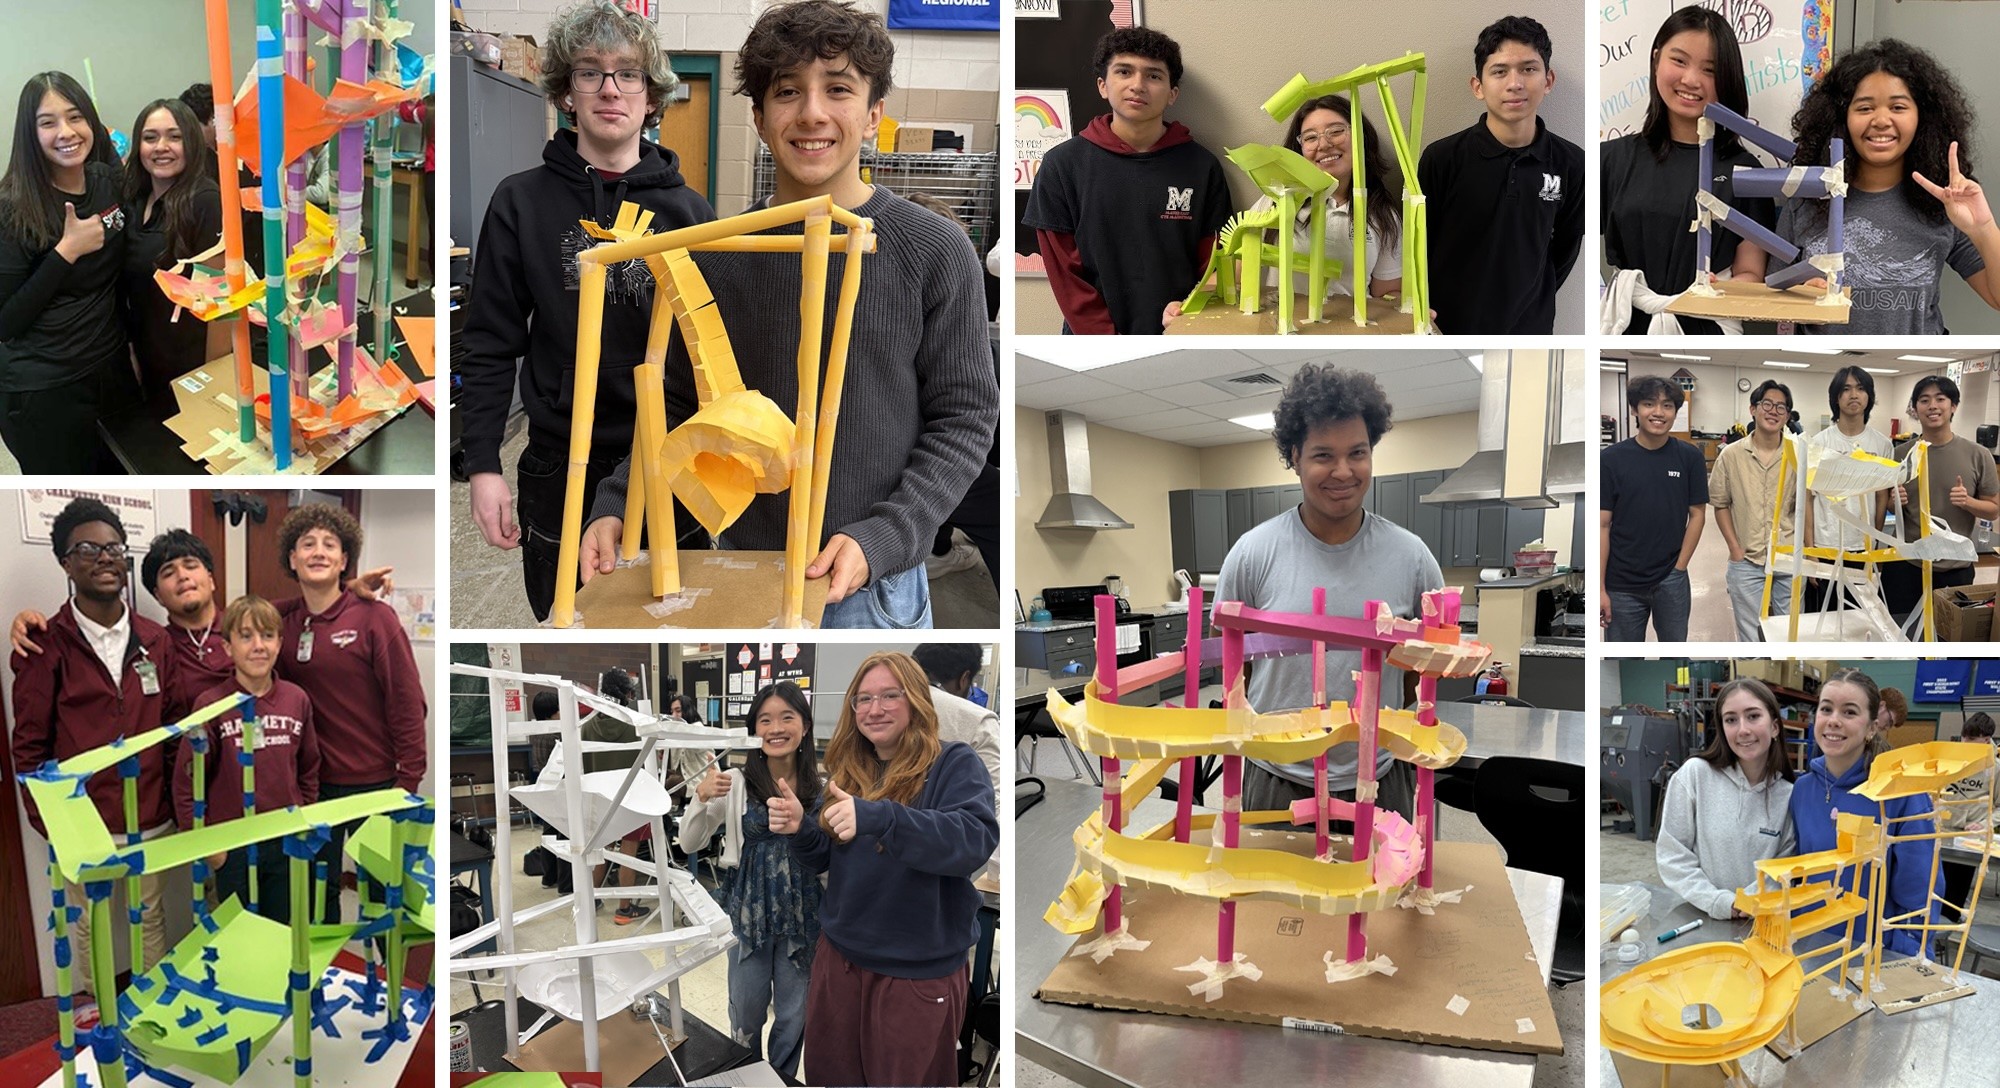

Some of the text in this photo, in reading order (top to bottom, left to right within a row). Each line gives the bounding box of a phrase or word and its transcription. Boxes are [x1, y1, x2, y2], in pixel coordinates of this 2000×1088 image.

[1542, 172, 1562, 194] M
[1166, 186, 1194, 211] M
[124, 497, 152, 510] SCHOOL
[220, 715, 303, 738] HAMETTE
[265, 735, 291, 745] CHOOL
